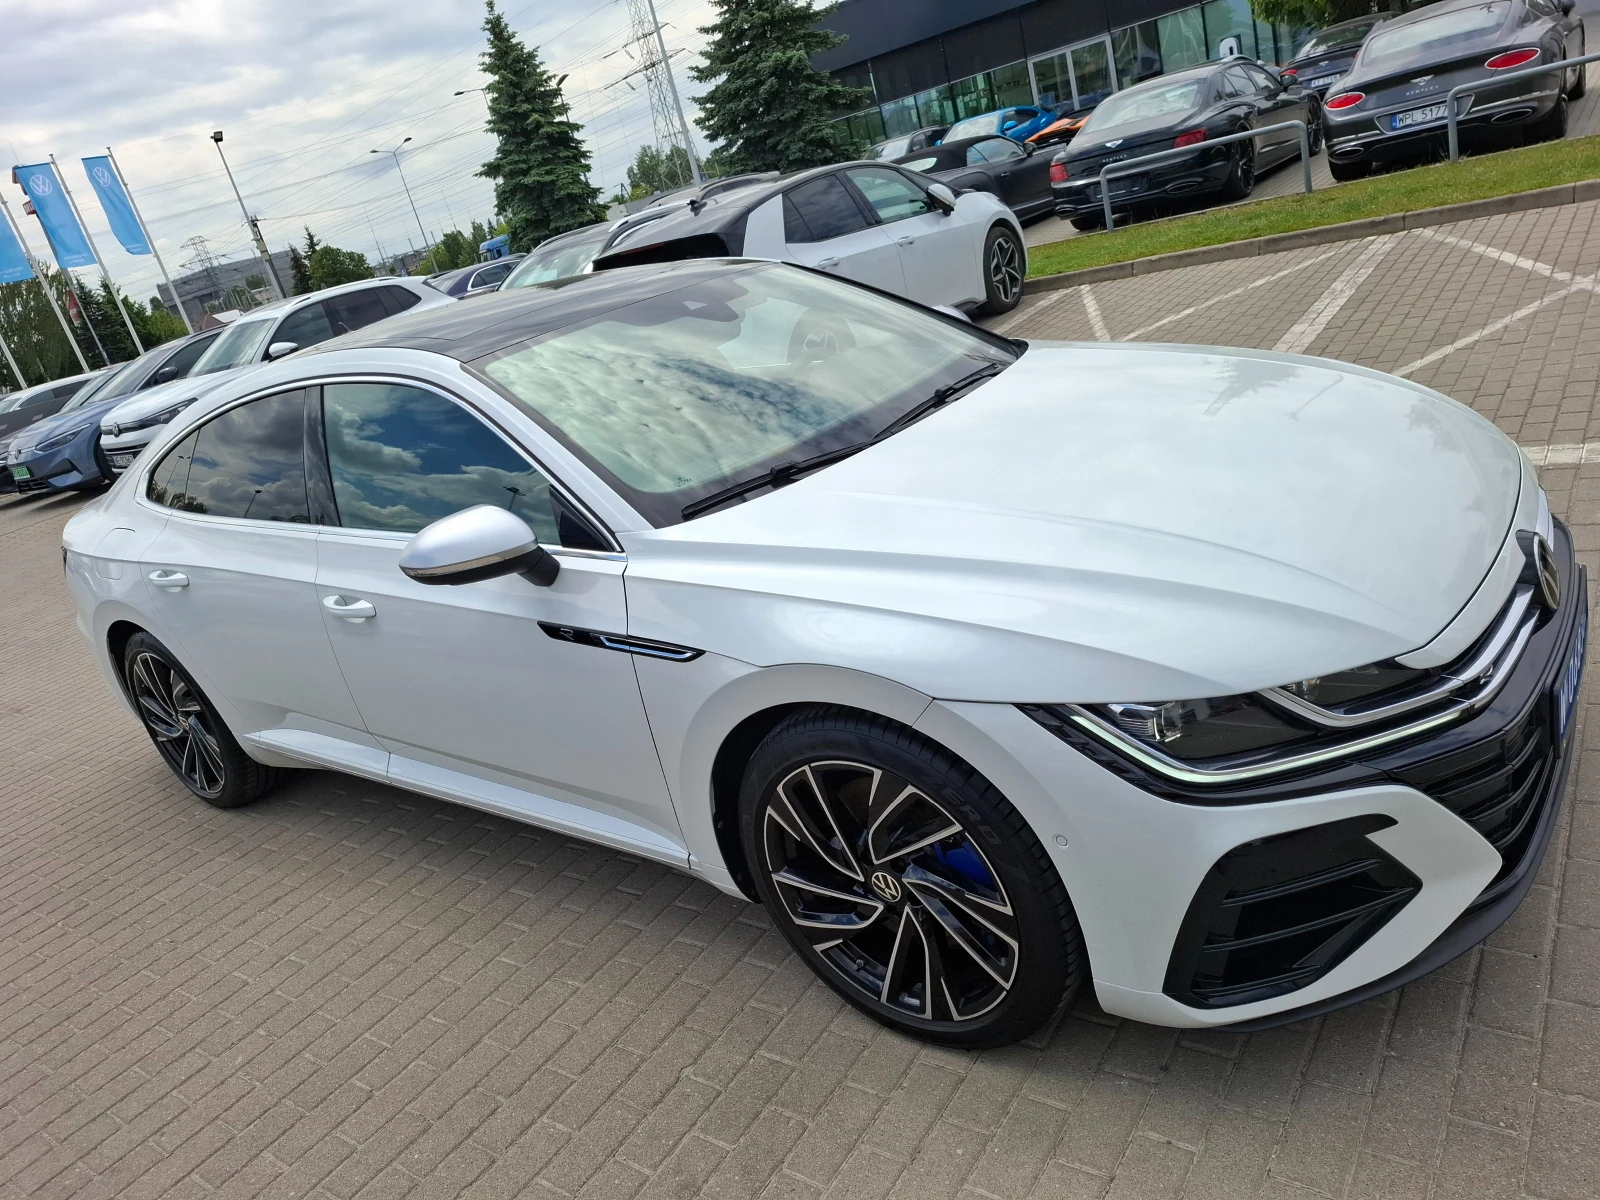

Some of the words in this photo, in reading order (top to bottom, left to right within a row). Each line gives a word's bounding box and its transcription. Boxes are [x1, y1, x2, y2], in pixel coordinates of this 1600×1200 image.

[1398, 111, 1417, 126] WPL
[1421, 104, 1448, 120] 5177
[871, 871, 902, 903] VW
